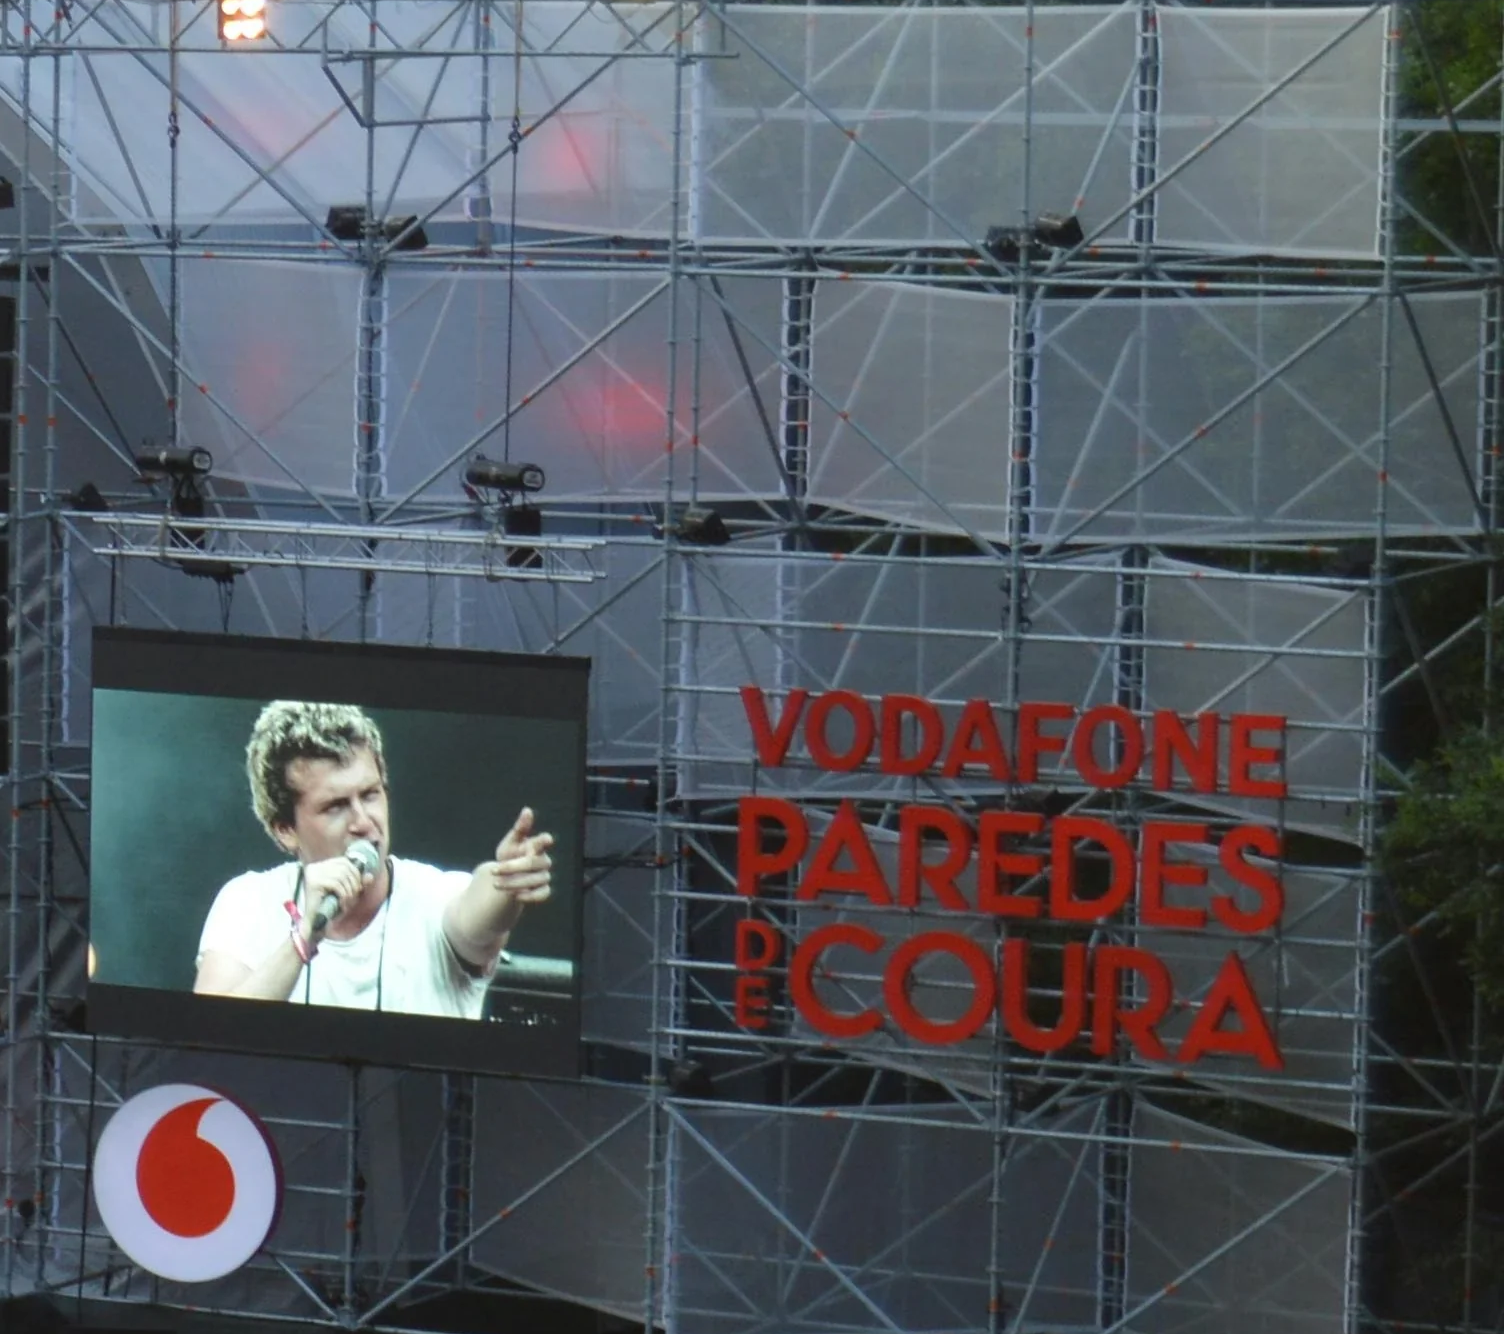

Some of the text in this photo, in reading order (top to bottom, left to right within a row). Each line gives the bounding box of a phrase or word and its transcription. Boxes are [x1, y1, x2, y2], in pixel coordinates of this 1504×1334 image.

[742, 686, 1288, 798] VODAFONE
[737, 795, 1285, 934] PAREDES
[735, 919, 1285, 1070] DE COURA
